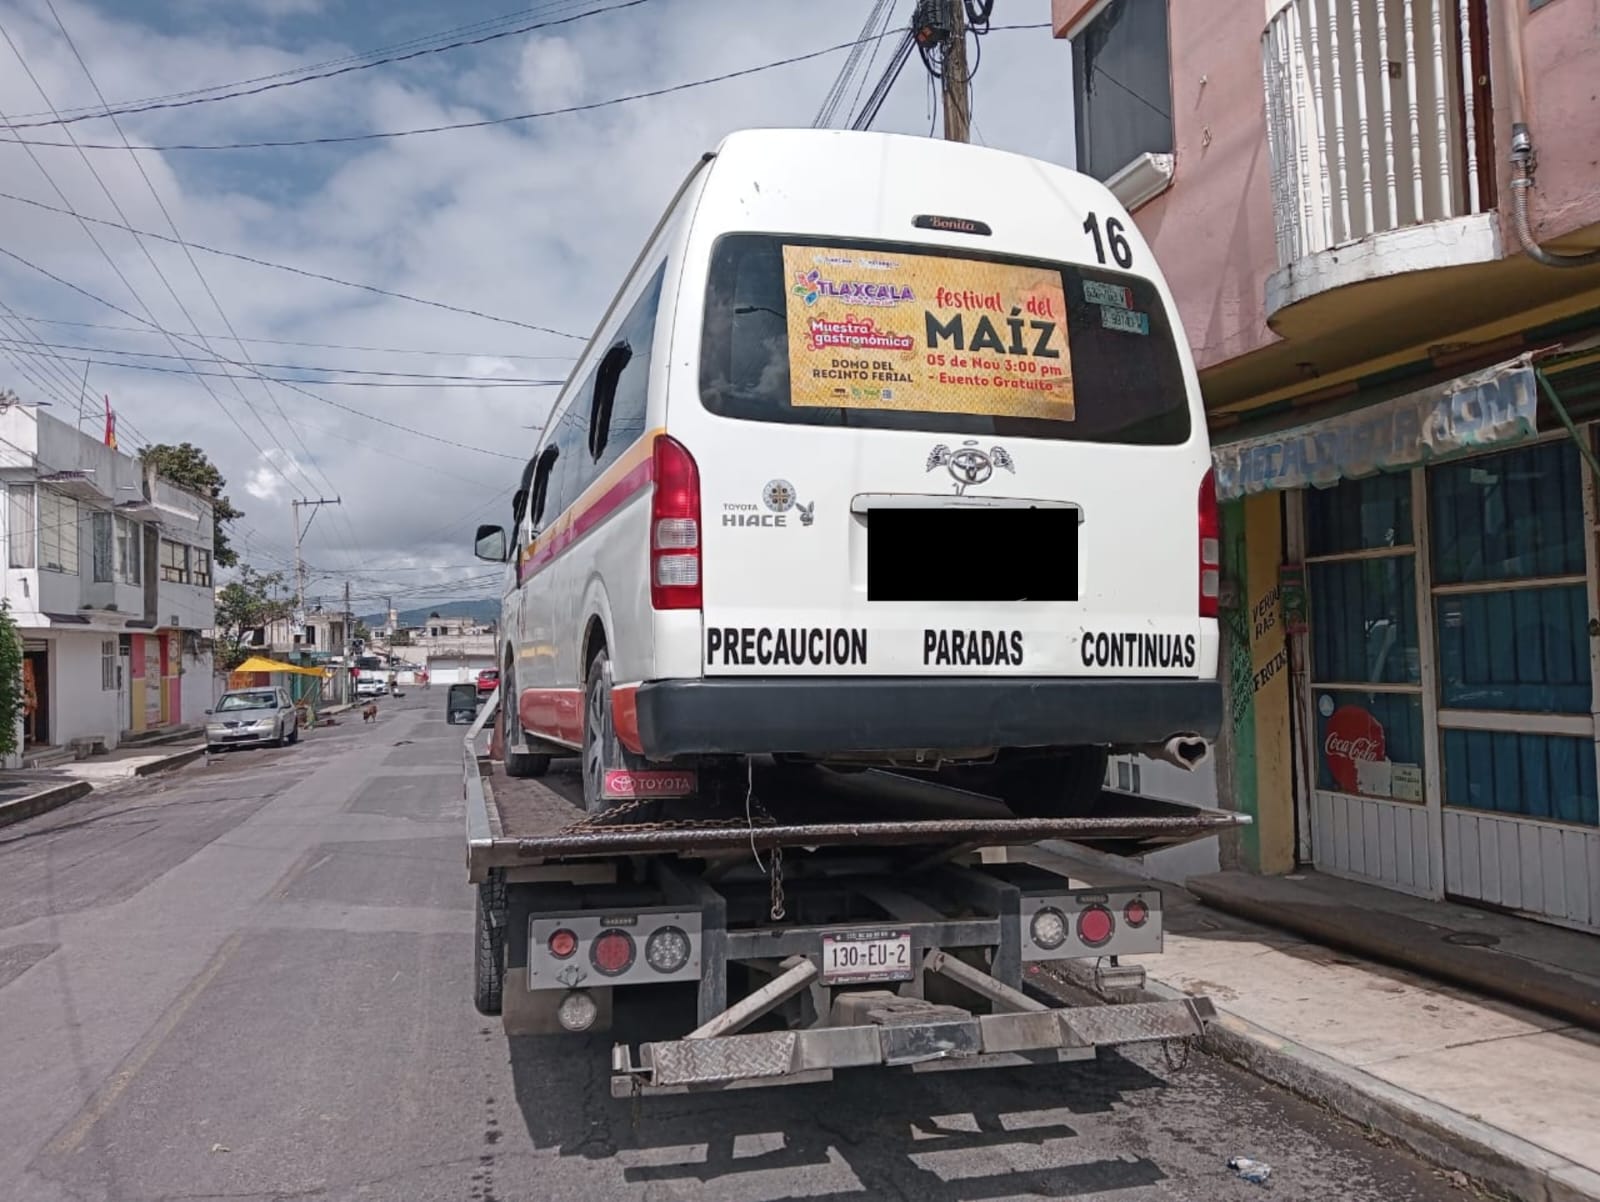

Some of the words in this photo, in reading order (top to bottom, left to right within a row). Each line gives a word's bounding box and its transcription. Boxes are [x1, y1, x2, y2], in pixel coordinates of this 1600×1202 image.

[1083, 211, 1133, 269] 16
[816, 280, 914, 300] TLAXCALA
[936, 287, 1004, 313] festival
[1027, 296, 1054, 317] del
[812, 321, 868, 334] Muestra
[925, 306, 1060, 358] MAÍZ
[815, 333, 910, 347] gastronómica
[831, 359, 869, 370] DOMO
[872, 361, 894, 372] DEL
[926, 354, 945, 366] 05
[950, 355, 967, 368] de
[1004, 359, 1036, 374] 3:00
[1041, 365, 1062, 377] pm
[813, 368, 869, 380] RECINTO
[872, 371, 914, 383] FERIAL
[993, 376, 1053, 391] Gratuito
[723, 503, 758, 511] TOYOTA
[722, 514, 787, 527] HIACE
[707, 627, 868, 666] PRECAUCION
[924, 629, 1023, 667] PARADAS
[1081, 631, 1196, 668] CONTINUAS
[1325, 731, 1380, 761] Coca-Cola
[638, 778, 690, 790] TOYOTA
[832, 944, 906, 968] 130-EU-2
